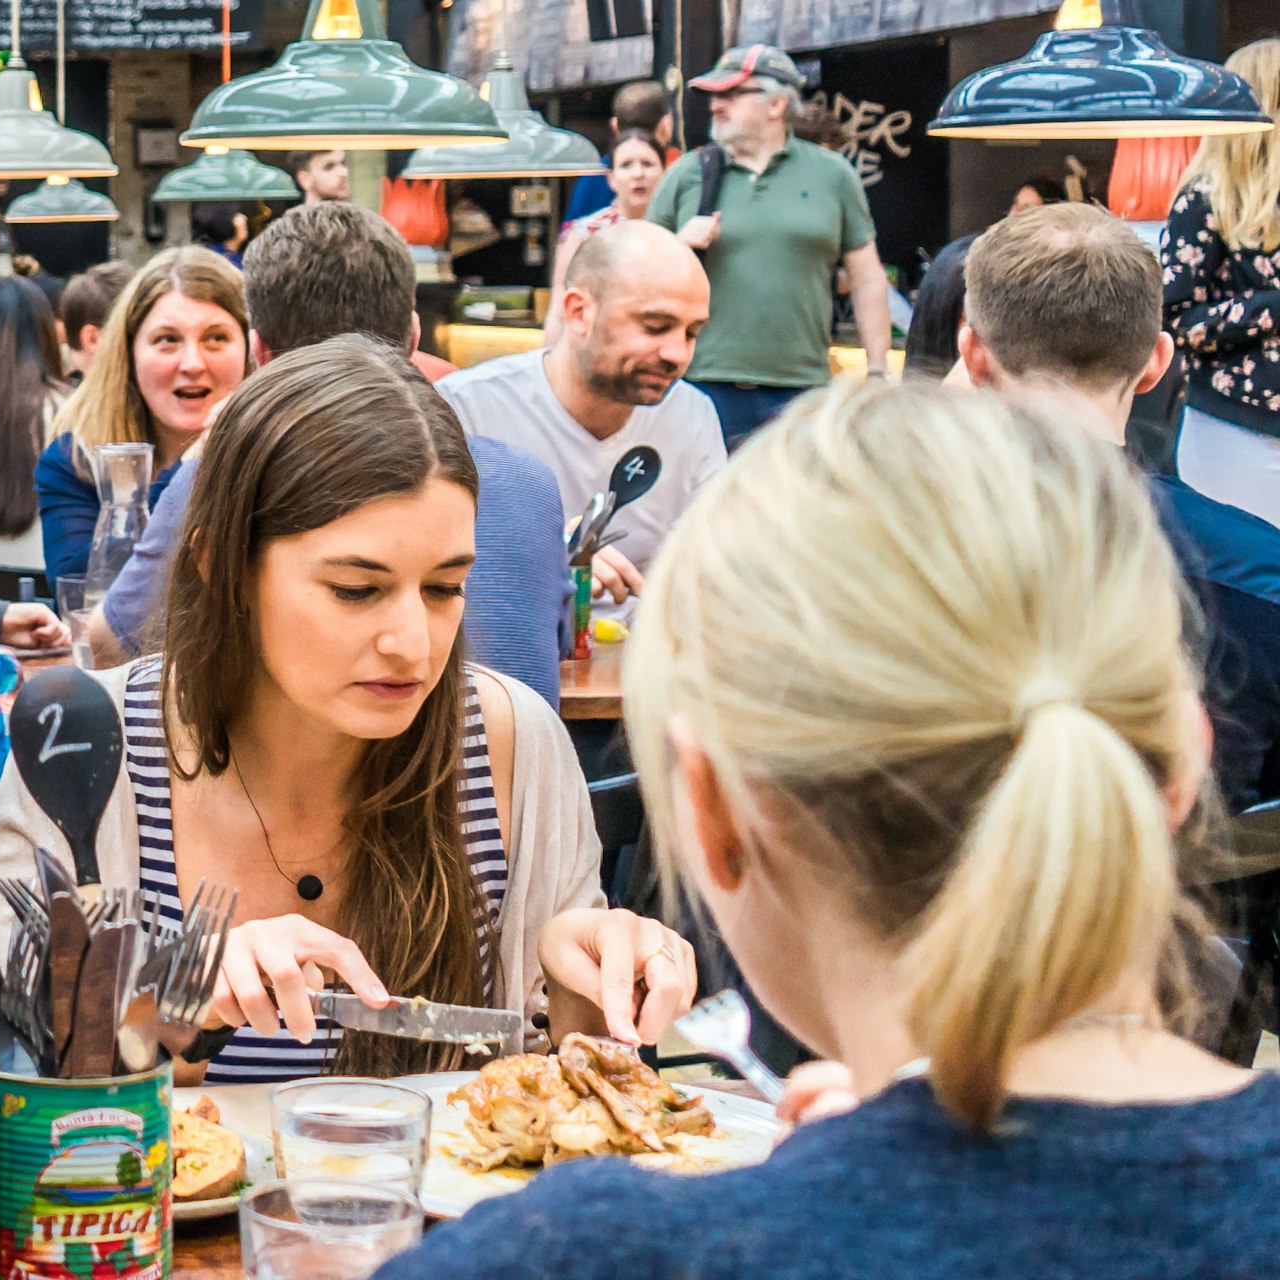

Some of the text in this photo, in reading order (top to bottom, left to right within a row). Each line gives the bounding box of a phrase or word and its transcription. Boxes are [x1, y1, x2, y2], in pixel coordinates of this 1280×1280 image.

[623, 455, 645, 483] 4
[37, 702, 93, 764] 2
[36, 1207, 155, 1242] TIPICA
